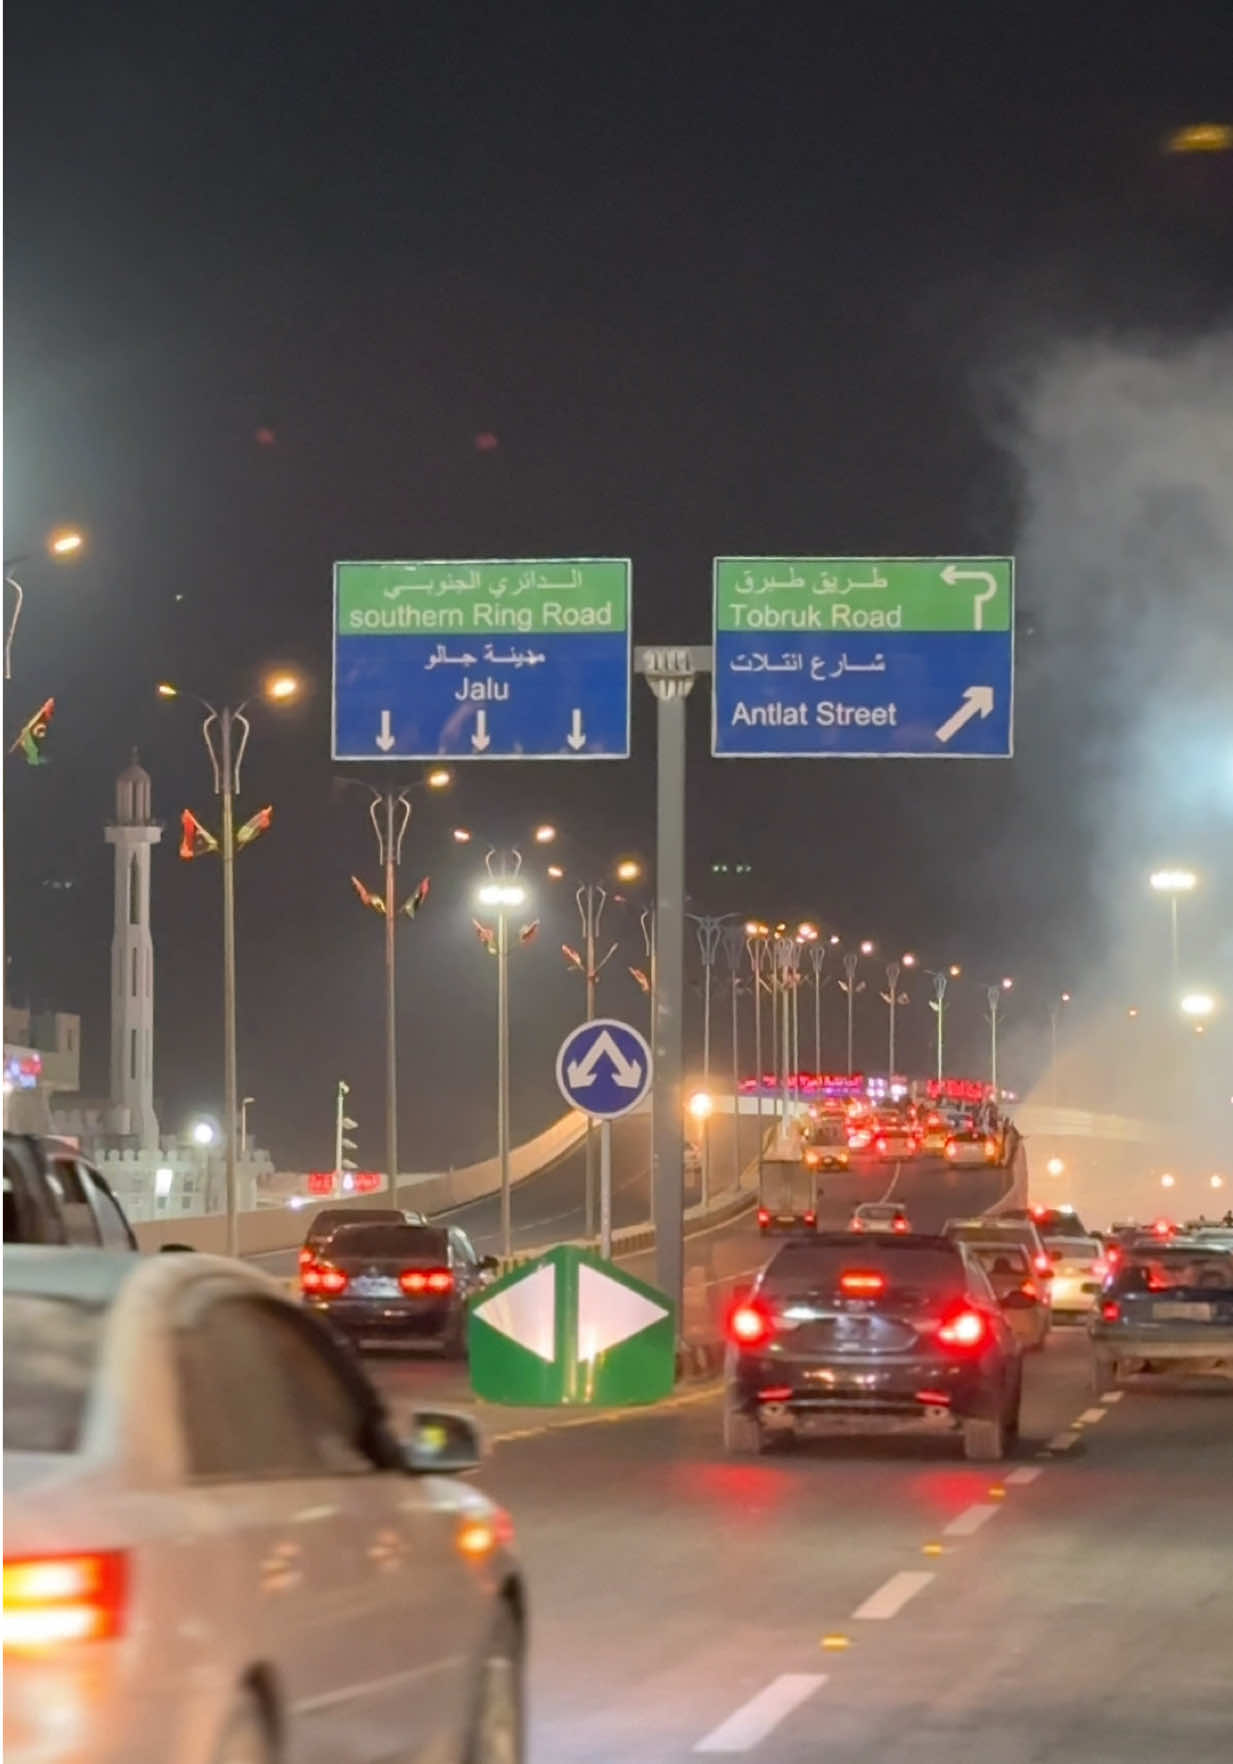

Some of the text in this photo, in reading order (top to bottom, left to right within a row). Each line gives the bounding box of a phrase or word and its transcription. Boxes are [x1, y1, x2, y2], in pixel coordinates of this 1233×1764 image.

[384, 570, 583, 600] الدائري الجنوبي
[734, 566, 888, 595] طريق طبرق
[349, 601, 613, 631] southern Ring Road
[730, 604, 902, 629] Tobruk Road
[423, 643, 546, 671] مدينة جالو
[810, 652, 887, 681] شارع
[455, 677, 510, 702] Jalu
[731, 701, 897, 727] Antlat Street
